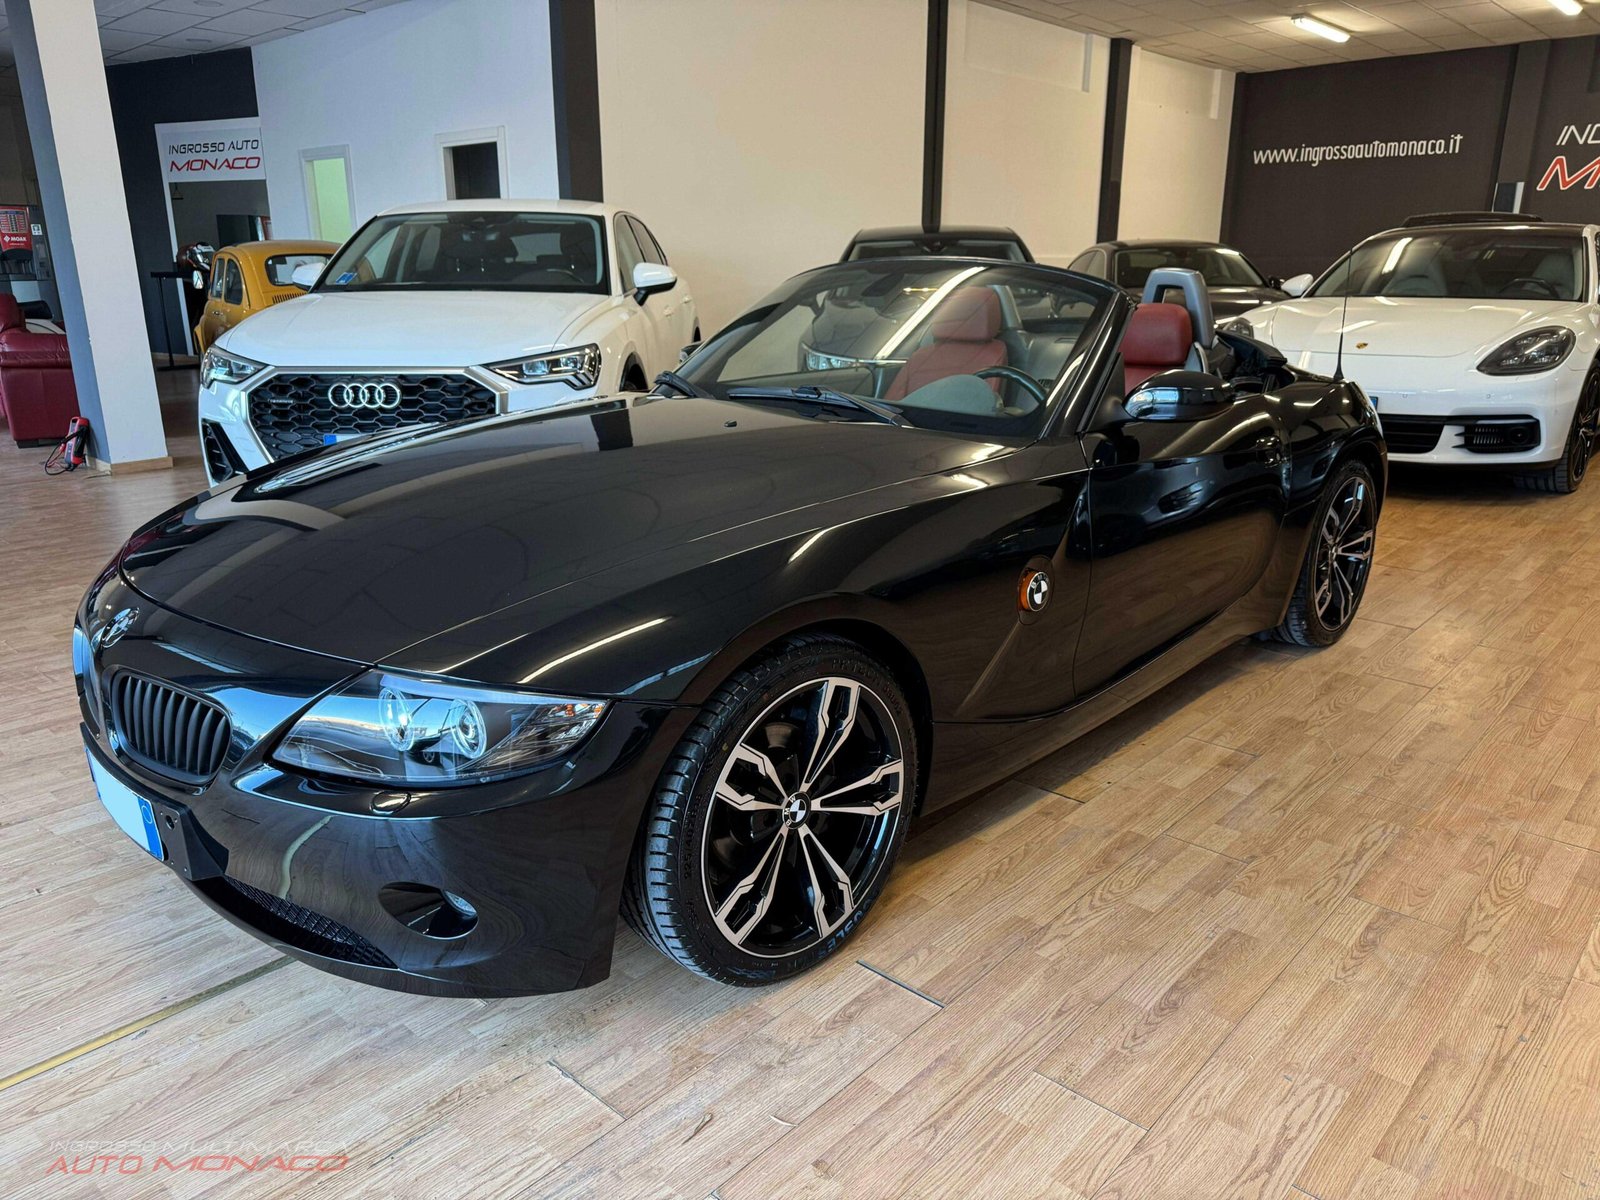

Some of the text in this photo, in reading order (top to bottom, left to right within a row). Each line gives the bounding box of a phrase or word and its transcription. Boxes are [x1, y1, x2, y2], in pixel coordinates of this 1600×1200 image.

[168, 139, 260, 155] INGROSSO AUTO
[1253, 133, 1463, 167] www.ingrossoautomonaco.it
[170, 156, 261, 172] MONACO
